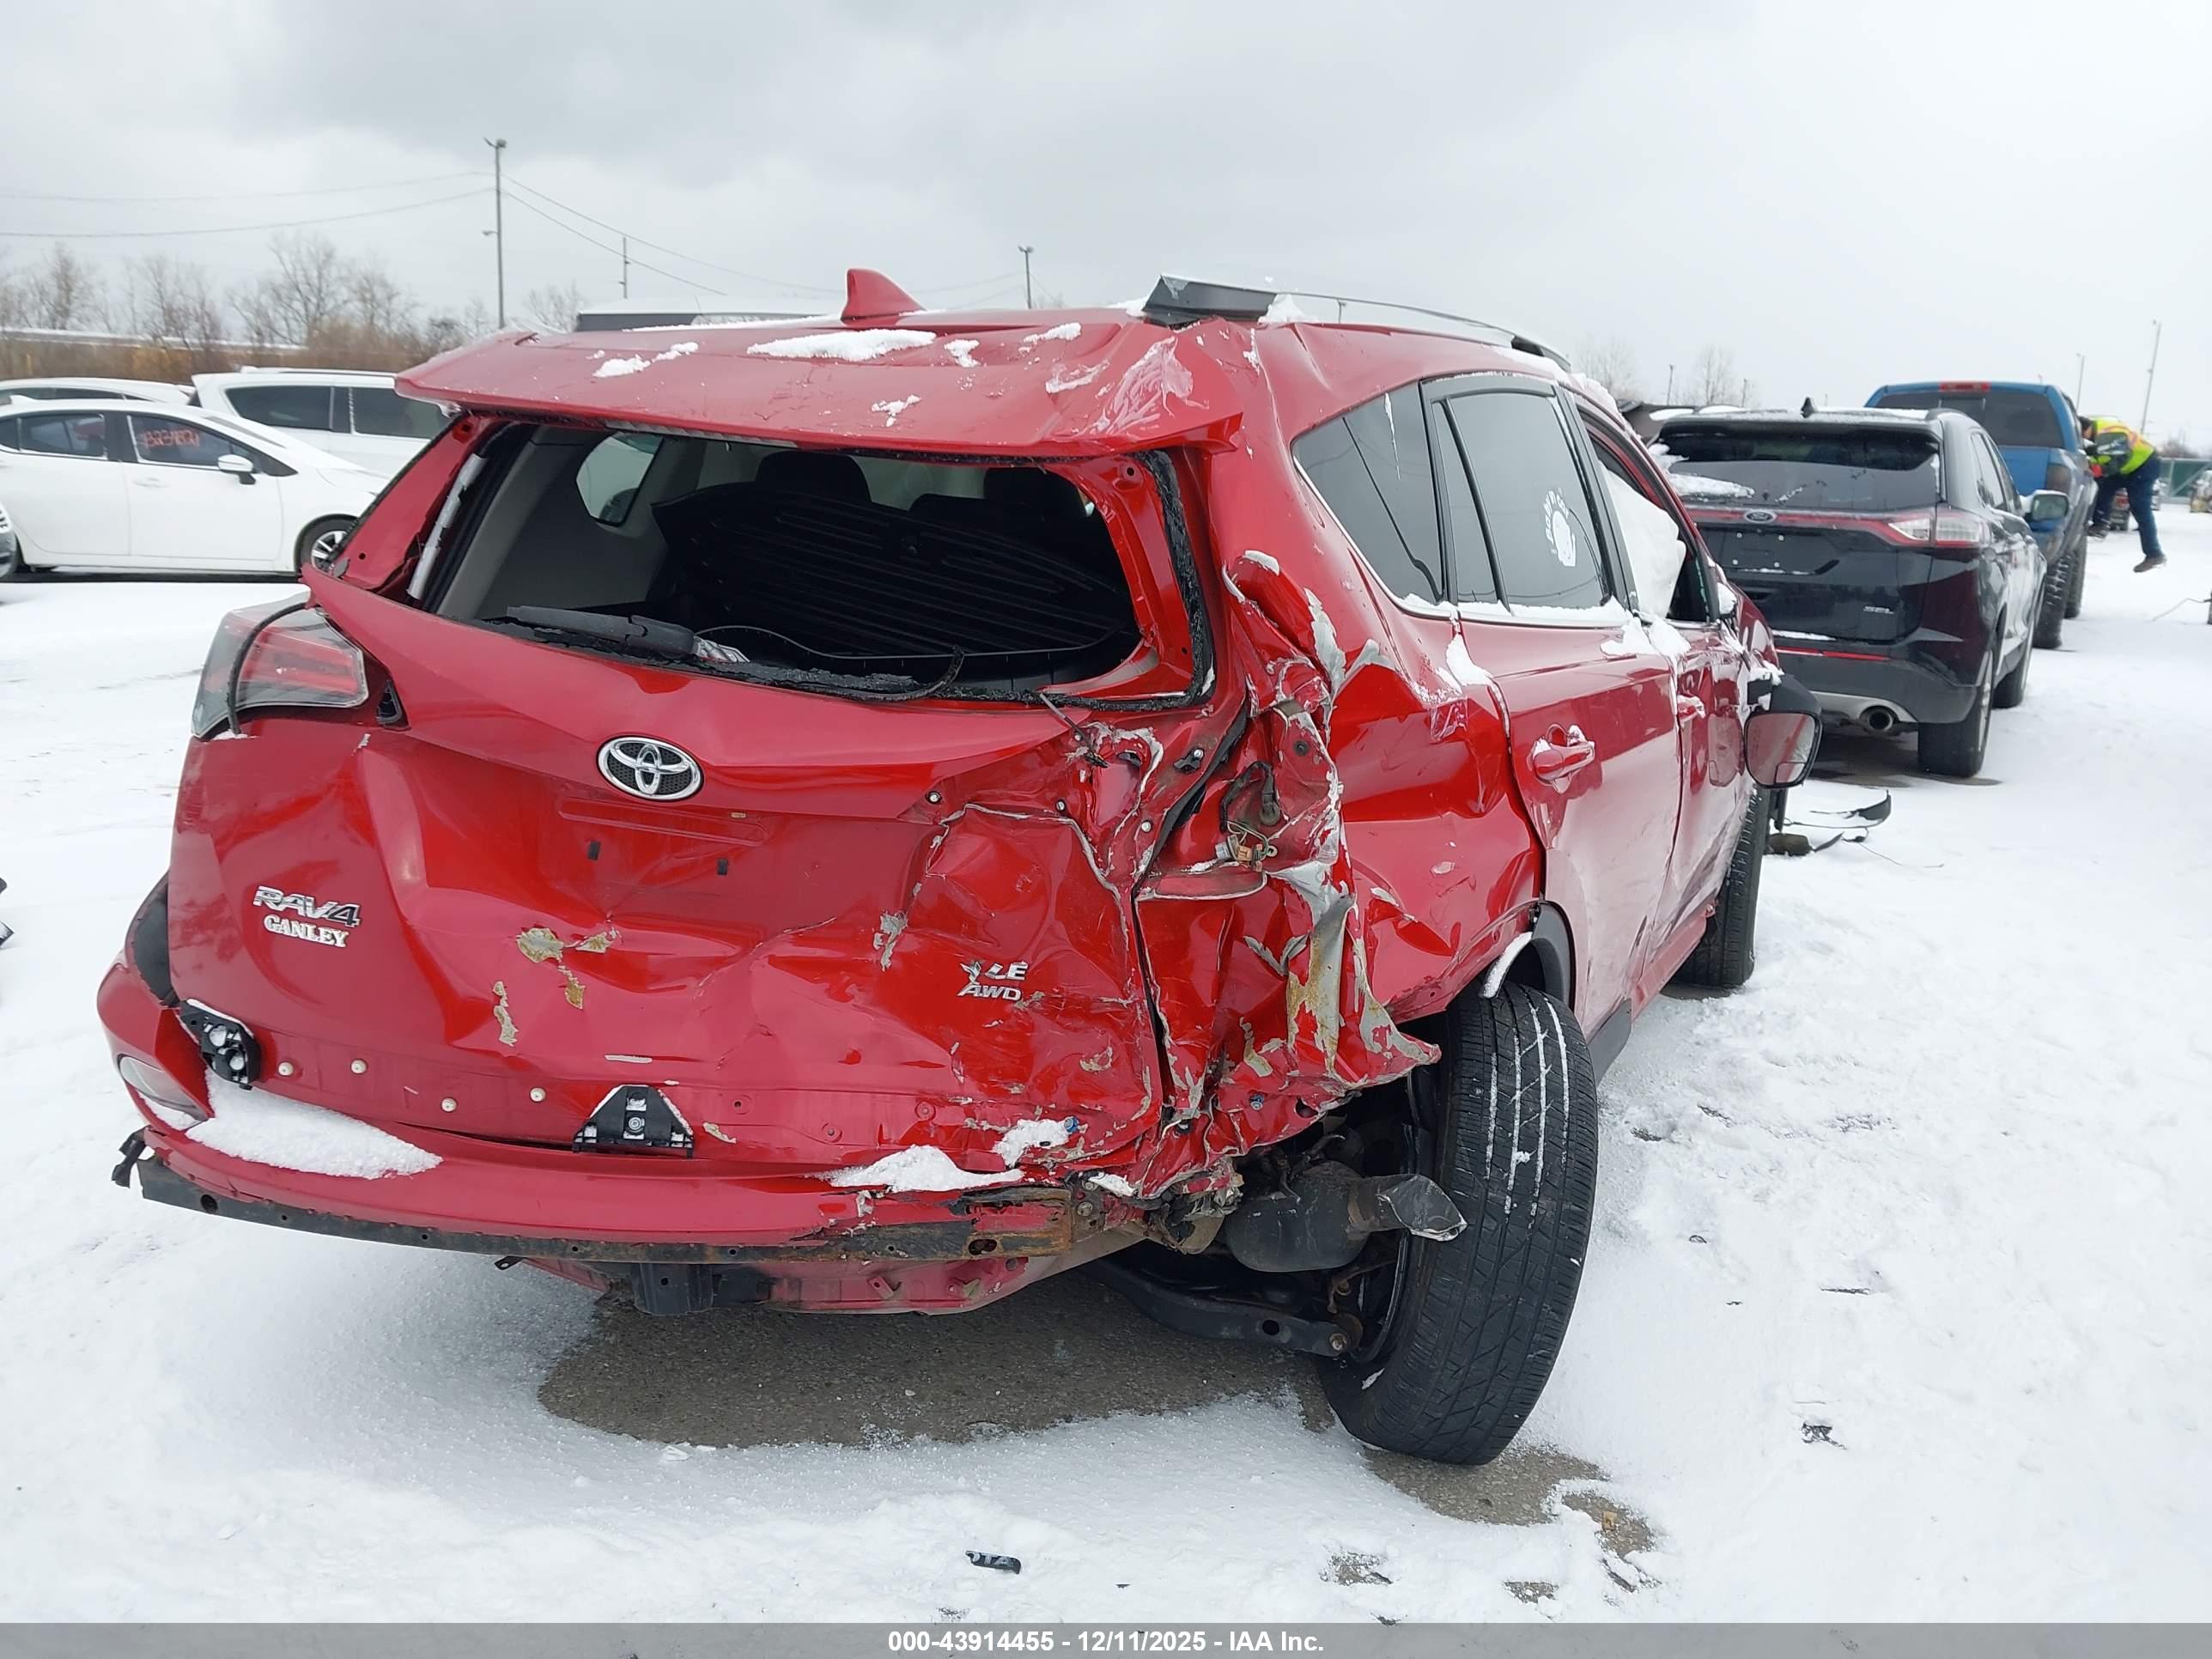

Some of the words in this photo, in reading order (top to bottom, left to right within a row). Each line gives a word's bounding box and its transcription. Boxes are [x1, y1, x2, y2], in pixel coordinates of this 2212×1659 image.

[252, 885, 361, 927] RAV4
[264, 914, 349, 947] GANLEY
[957, 983, 1022, 1001] AWD
